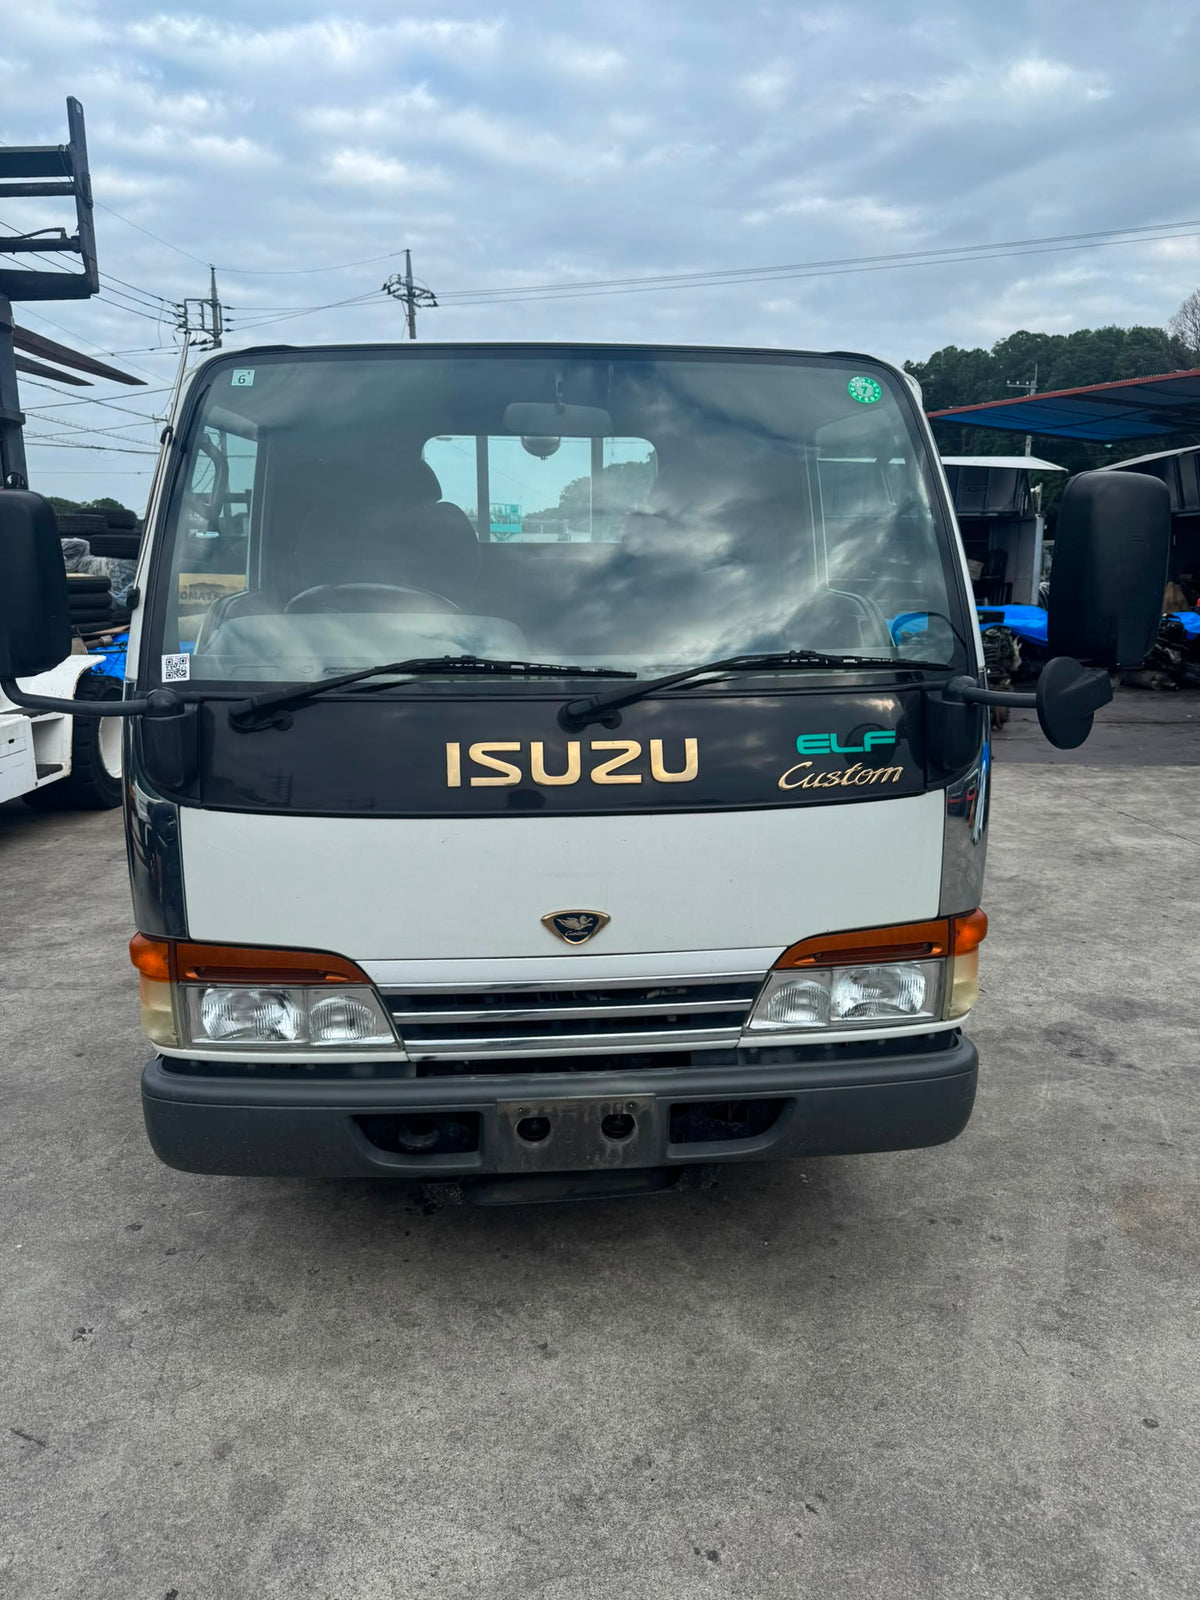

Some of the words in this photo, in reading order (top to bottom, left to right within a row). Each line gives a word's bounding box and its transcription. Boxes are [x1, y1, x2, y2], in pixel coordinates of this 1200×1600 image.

[238, 375, 246, 384] 6
[861, 386, 868, 395] 7
[796, 730, 896, 755] ELF
[446, 738, 699, 788] ISUZU
[778, 761, 904, 791] Custom
